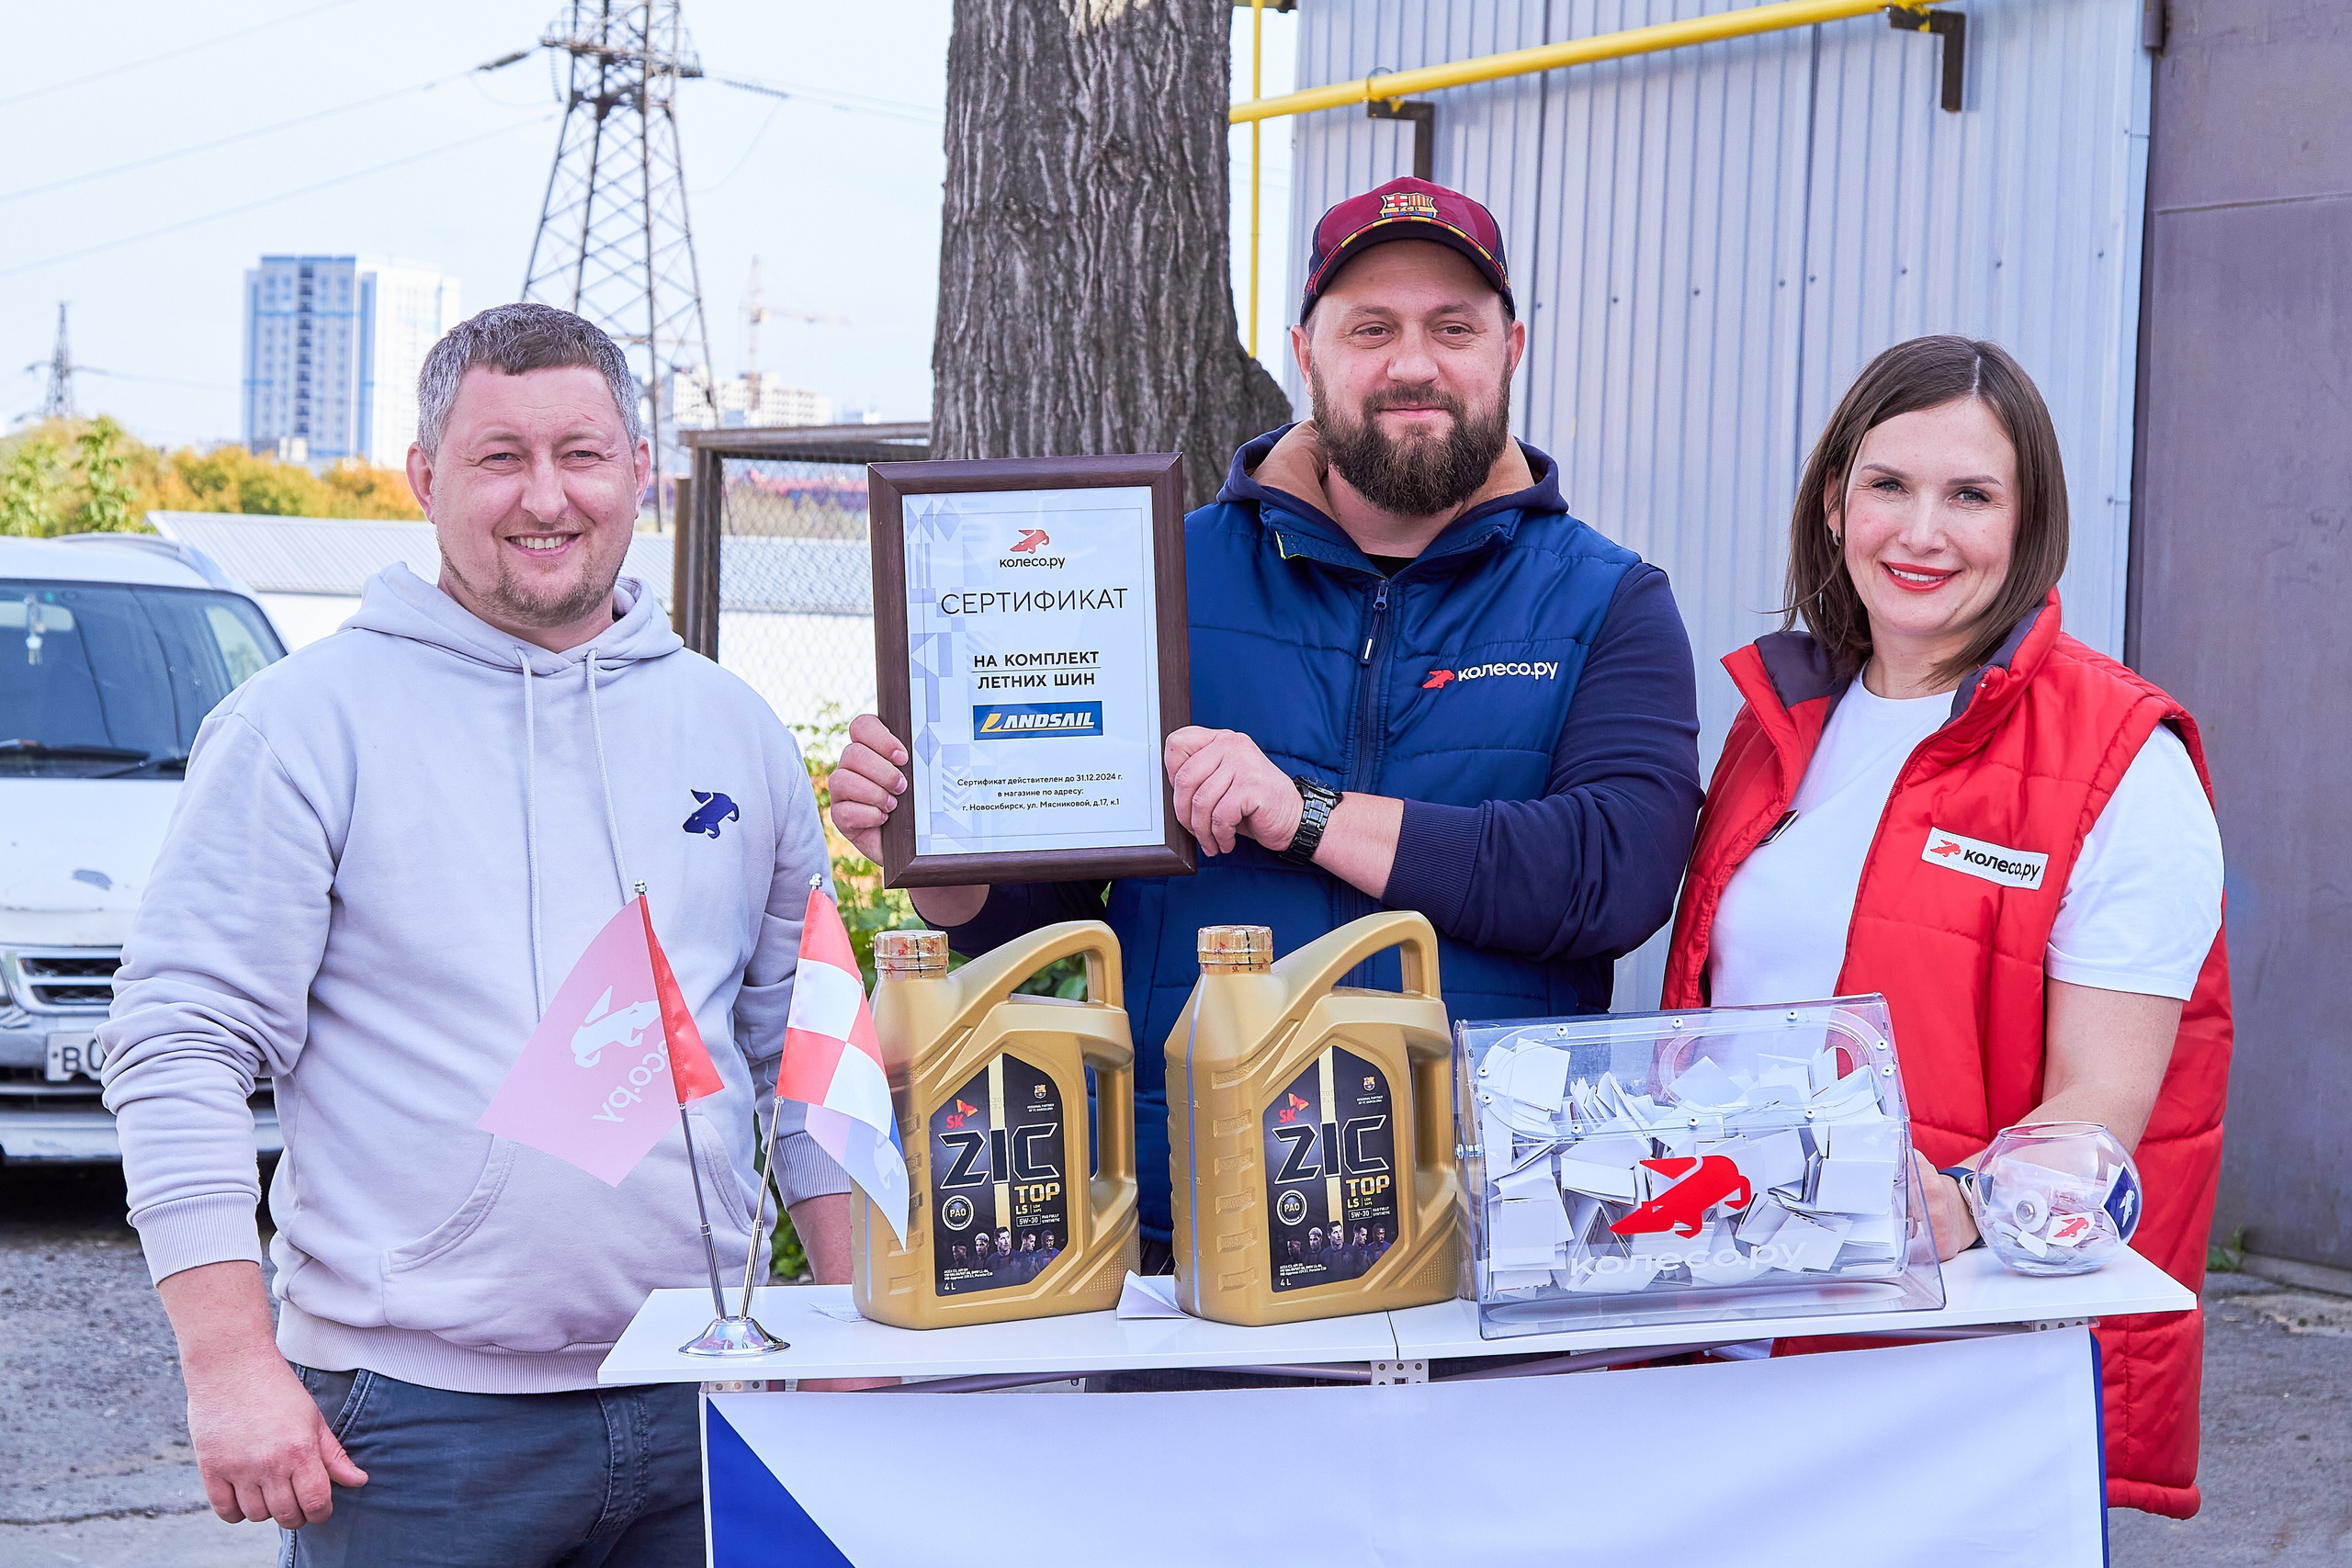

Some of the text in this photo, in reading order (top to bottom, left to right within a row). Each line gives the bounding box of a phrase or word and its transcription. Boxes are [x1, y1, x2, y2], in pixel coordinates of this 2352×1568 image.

[999, 556, 1066, 569] колесо.ру
[941, 588, 1128, 615] СЕРТИФИКАТ
[974, 650, 1100, 668] НА КОМПЛЕКТ
[1457, 661, 1559, 682] колесо.ру
[978, 672, 1095, 689] ЛЕТНИХ ШИН
[979, 712, 1095, 733] LANDSAIL
[956, 777, 1006, 787] Сертификат
[1007, 775, 1063, 785] действителен
[1076, 773, 1116, 782] 31.12.2024
[1003, 789, 1041, 797] магазине
[1053, 788, 1084, 797] адресу:
[969, 802, 1025, 811] Новосибирск,
[1026, 802, 1038, 810] ул.
[1039, 799, 1091, 808] Мясниковой,
[1963, 849, 2041, 882] колесо.ру
[946, 1114, 966, 1130] SK
[1279, 1108, 1297, 1123] SK
[938, 1122, 1060, 1190] ZIC
[1272, 1114, 1390, 1185] ZIC
[1013, 1181, 1060, 1204] TOP
[1345, 1175, 1390, 1198] TOP
[1015, 1204, 1028, 1215] LS
[1347, 1198, 1360, 1209] LS
[1019, 1216, 1038, 1225] 5W-30
[1351, 1209, 1370, 1218] 5W-30
[1570, 1242, 1807, 1277] колесо.ру
[944, 1282, 950, 1291] 4
[1280, 1278, 1292, 1286] 4 L
